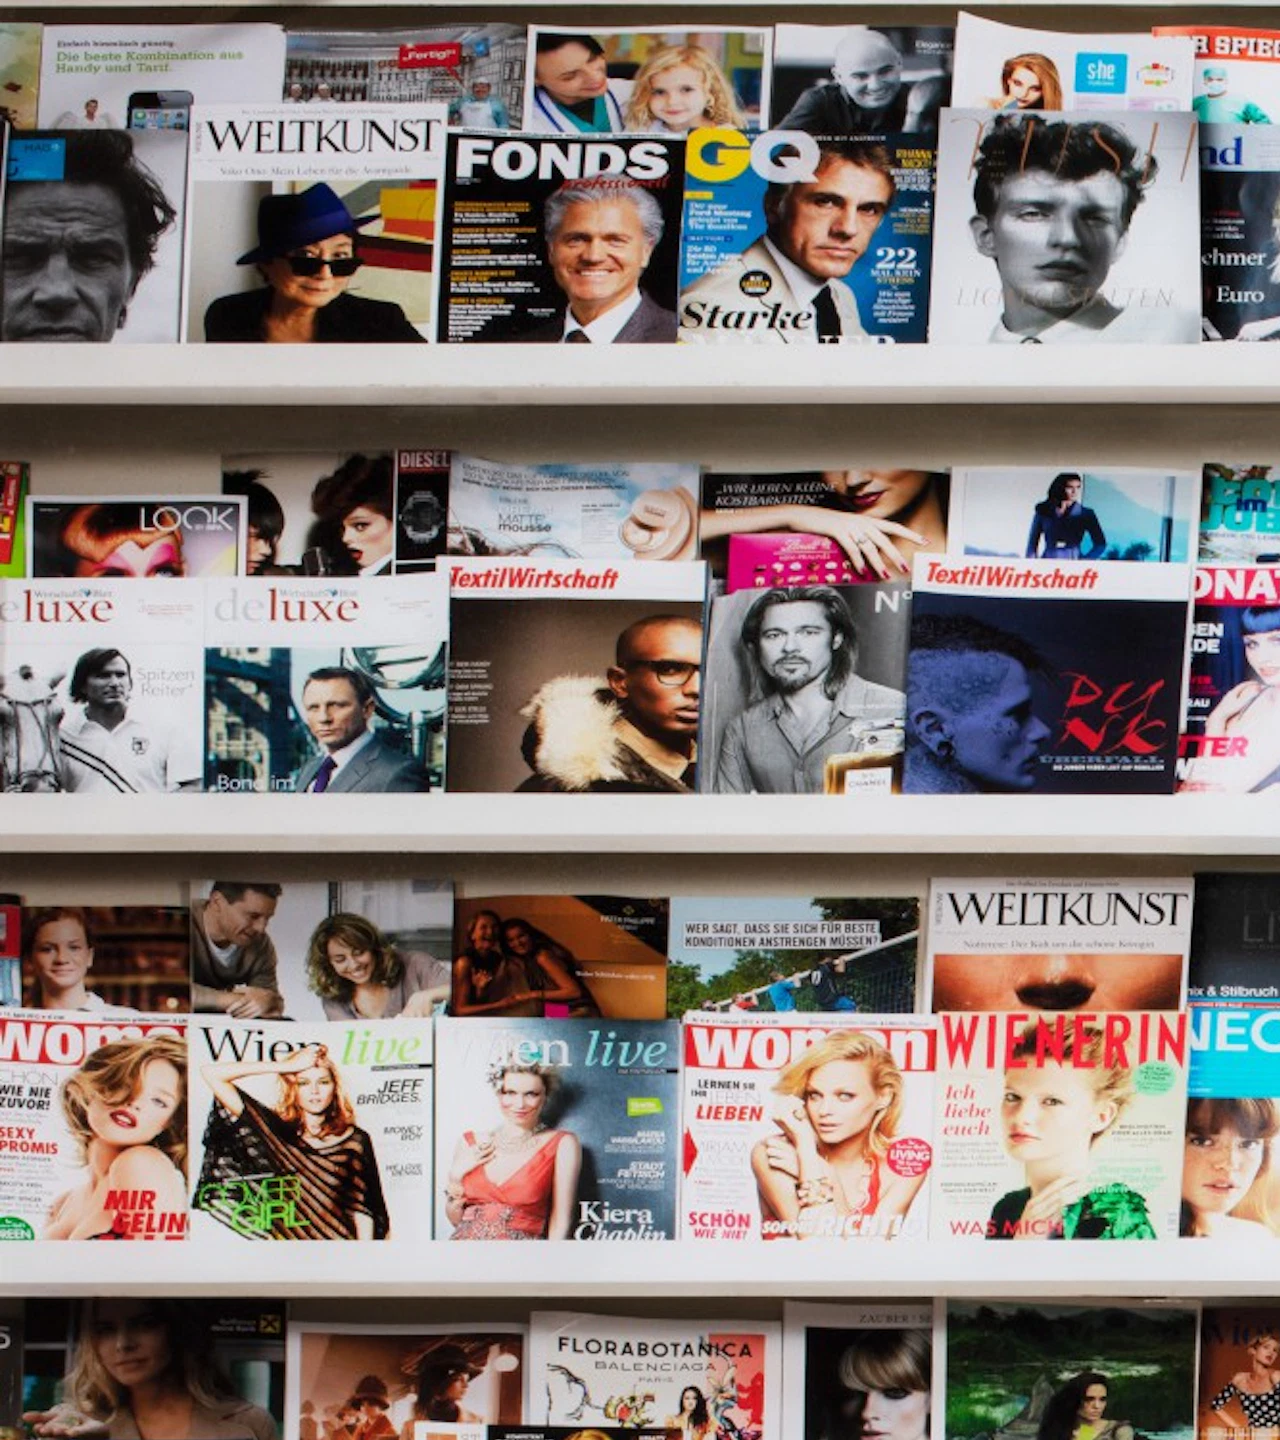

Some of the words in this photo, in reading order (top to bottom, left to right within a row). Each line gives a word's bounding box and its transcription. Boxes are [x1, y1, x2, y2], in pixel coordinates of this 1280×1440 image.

[100, 63, 132, 73] und
[208, 120, 442, 155] WELTKUNST
[456, 141, 670, 181] FONDS
[684, 129, 822, 185] GQ
[680, 304, 815, 332] Starke
[450, 567, 619, 592] TextilWirtschaft
[927, 564, 1101, 590] TextilWirtschaft
[214, 587, 361, 624] deluxe
[949, 892, 1189, 927] WELTKUNST
[685, 924, 710, 935] WER
[713, 924, 744, 937] SAGT,
[746, 924, 772, 935] DASS
[774, 924, 791, 935] SIE
[794, 923, 817, 935] SICH
[820, 921, 841, 935] FÜR
[845, 923, 877, 935] BESTE
[685, 937, 754, 948] KONDITIONEN
[758, 936, 830, 948] ANSTRENGEN
[833, 934, 879, 947] MÜSSEN?
[1219, 985, 1279, 998] Stilbruch
[342, 1030, 423, 1065] live
[943, 1015, 1187, 1069] WIENERIN
[376, 1079, 425, 1093] JEFF
[696, 1105, 763, 1121] LIEBEN
[945, 1104, 991, 1119] liebe
[688, 1212, 751, 1227] SCHÖN
[557, 1337, 752, 1357] FLORABOTANICA
